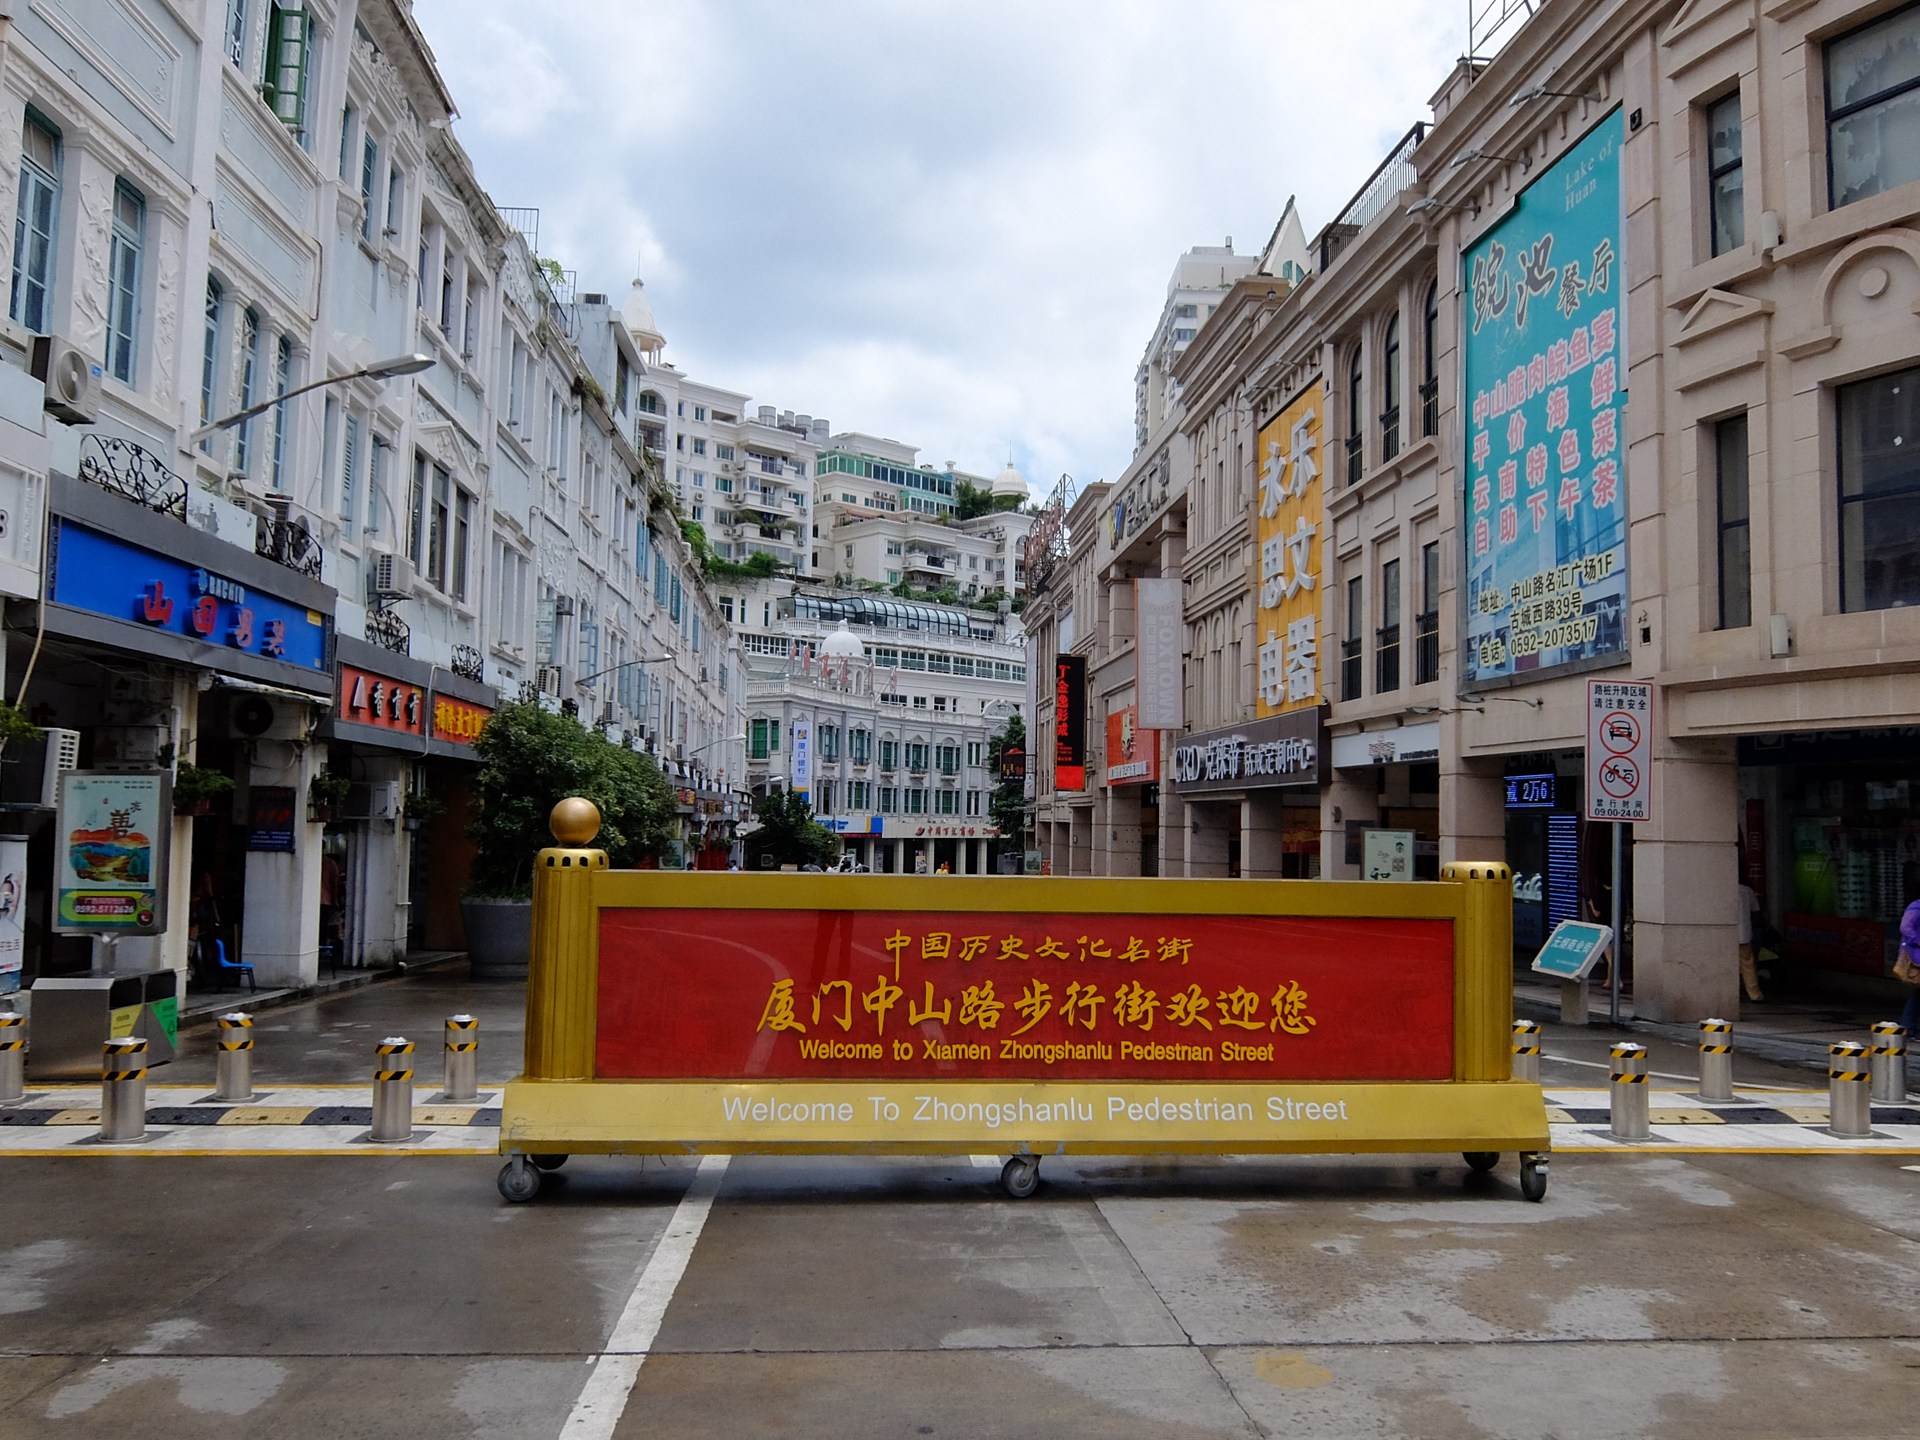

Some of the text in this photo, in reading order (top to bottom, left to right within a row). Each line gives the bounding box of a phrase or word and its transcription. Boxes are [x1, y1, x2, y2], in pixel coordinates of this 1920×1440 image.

[1565, 134, 1615, 190] Lake of
[1565, 177, 1597, 212] Huan
[1473, 308, 1616, 431] 中山脆肉鲩鱼宴
[1510, 595, 1583, 631] 古城西路39号
[1159, 614, 1176, 724] FOXTOWN
[1594, 684, 1647, 698] 路桩升降区域
[1594, 698, 1647, 711] 请注意安全
[1175, 744, 1201, 783] CRD
[885, 929, 1194, 981] 中国历史文化名街
[756, 975, 1317, 1037] 厦门中山路步行街欢迎您
[800, 1039, 1274, 1064] Welcome to Xiamen Zhongshanlu Pedestrian Street
[722, 1096, 1349, 1129] Welcome To Zhongshanlu Pedestrian Street
